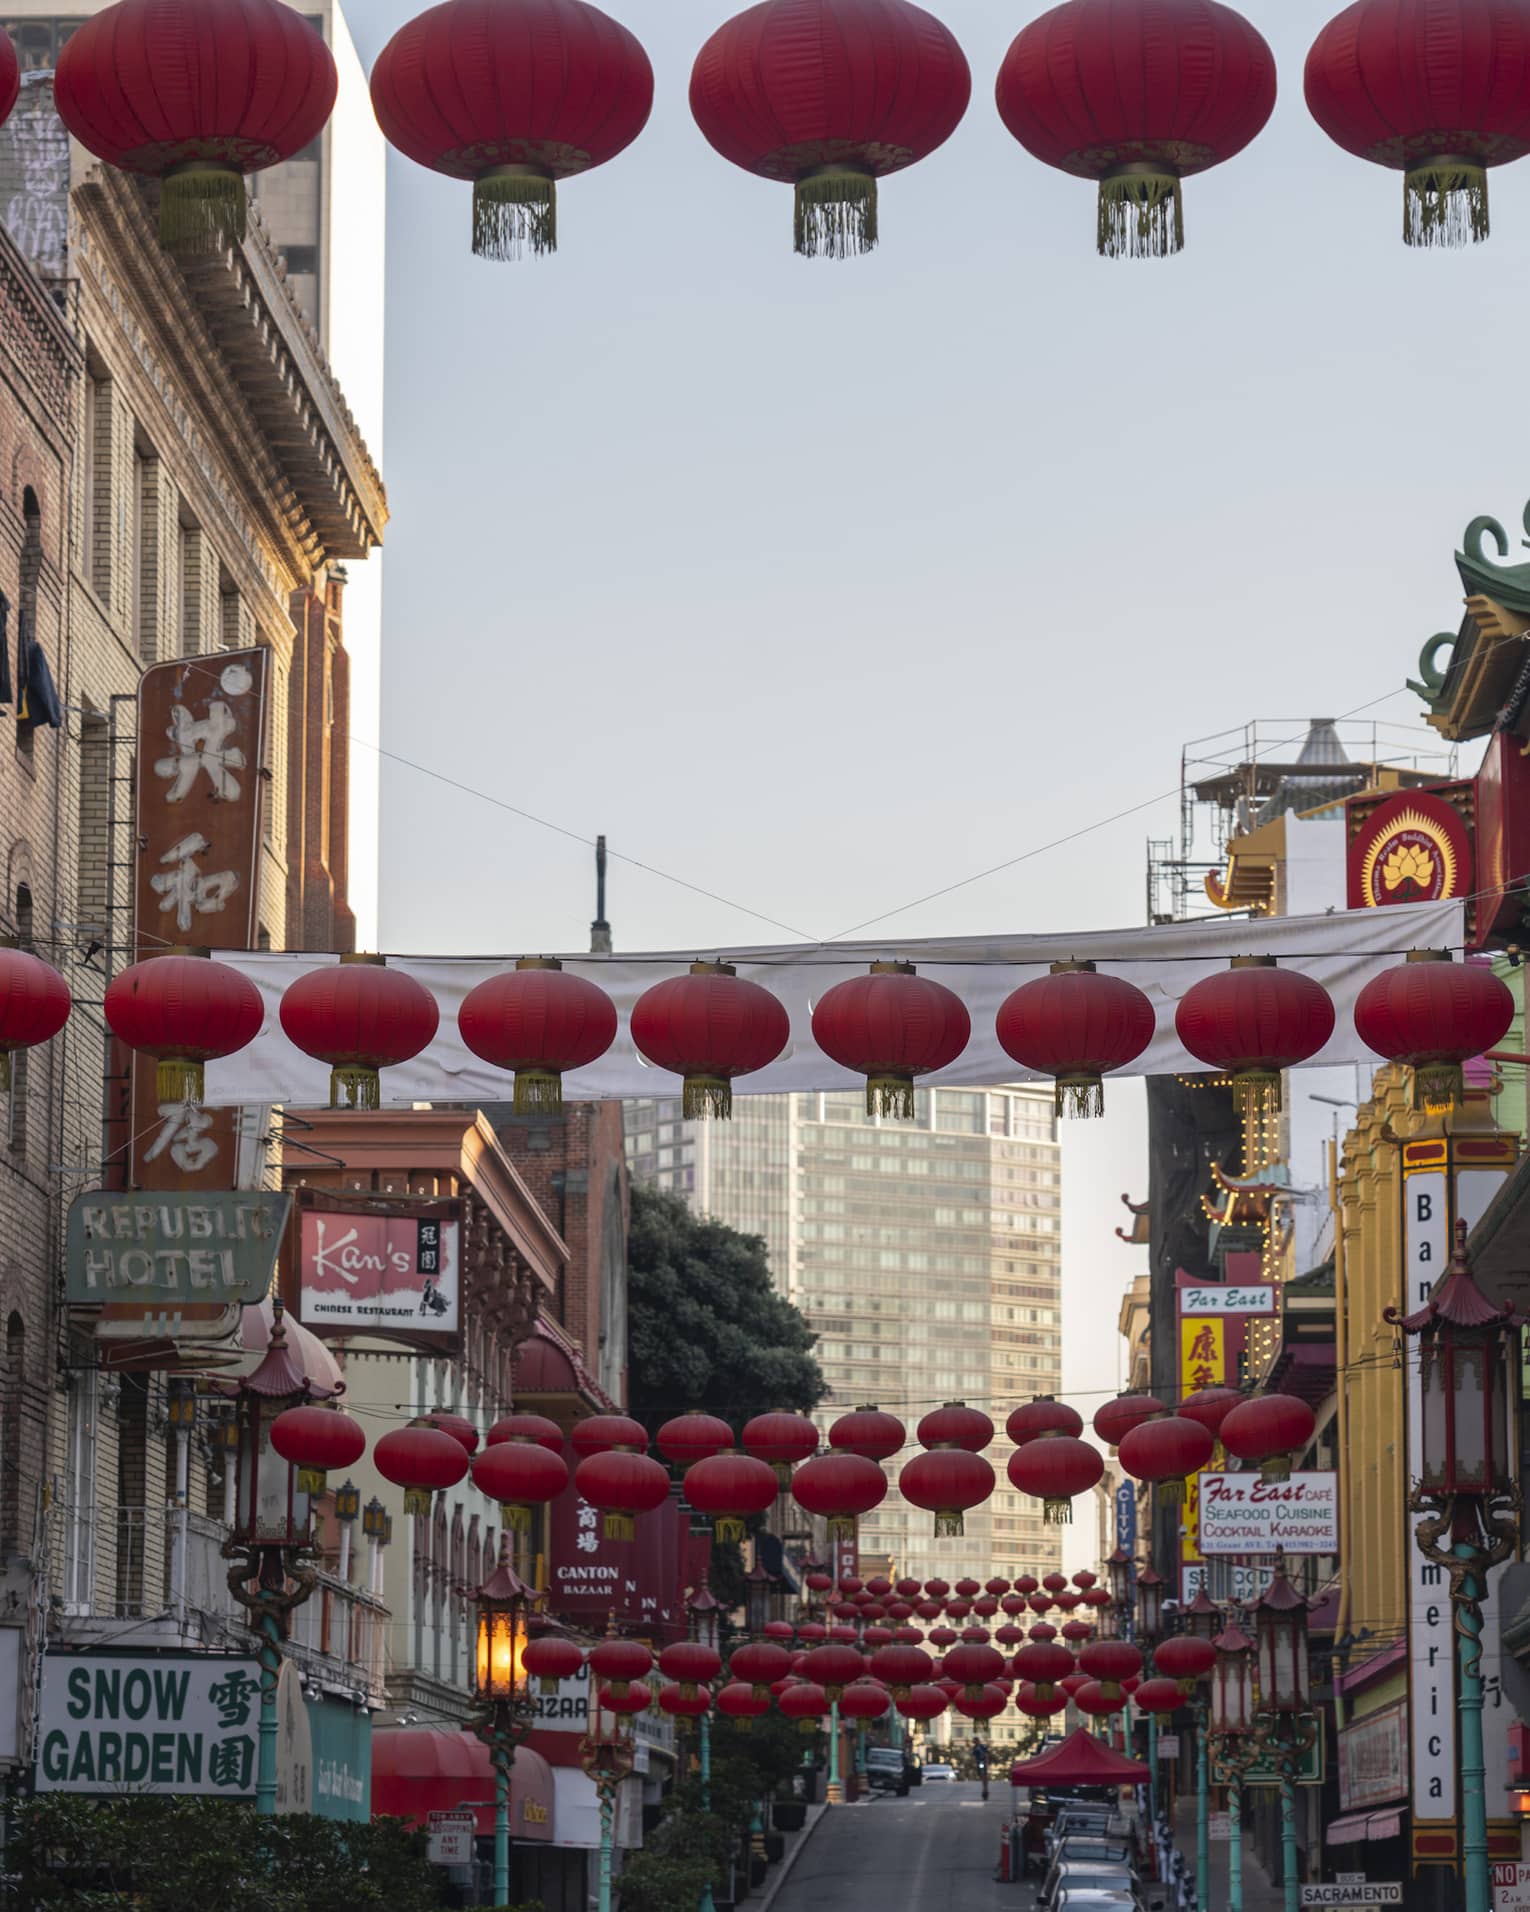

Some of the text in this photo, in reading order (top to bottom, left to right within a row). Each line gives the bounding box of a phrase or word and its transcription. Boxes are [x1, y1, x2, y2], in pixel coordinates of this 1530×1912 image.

[82, 1205, 273, 1240] REPUBLIC
[311, 1219, 411, 1284] Kan's
[85, 1249, 251, 1289] HOTEL
[1187, 1288, 1267, 1308] Far East
[314, 1303, 414, 1318] CHINESE RESTAURANT
[1203, 1477, 1246, 1505] Far
[1249, 1479, 1307, 1504] East
[1118, 1489, 1130, 1539] CITY
[1205, 1504, 1333, 1520] SEAFOOD CUISINE
[1203, 1521, 1333, 1538] COCKTAIL KARAOKE
[557, 1566, 619, 1579] CANTON
[563, 1585, 613, 1595] BAZAAR
[1419, 1516, 1442, 1798] merica
[67, 1667, 192, 1721] SNOW
[208, 1669, 261, 1791] 雪園
[42, 1729, 203, 1784] GARDEN
[441, 1835, 459, 1844] ANY
[440, 1846, 460, 1855] TIME
[1495, 1865, 1515, 1884] NO
[1304, 1886, 1400, 1902] SACRAMENTO
